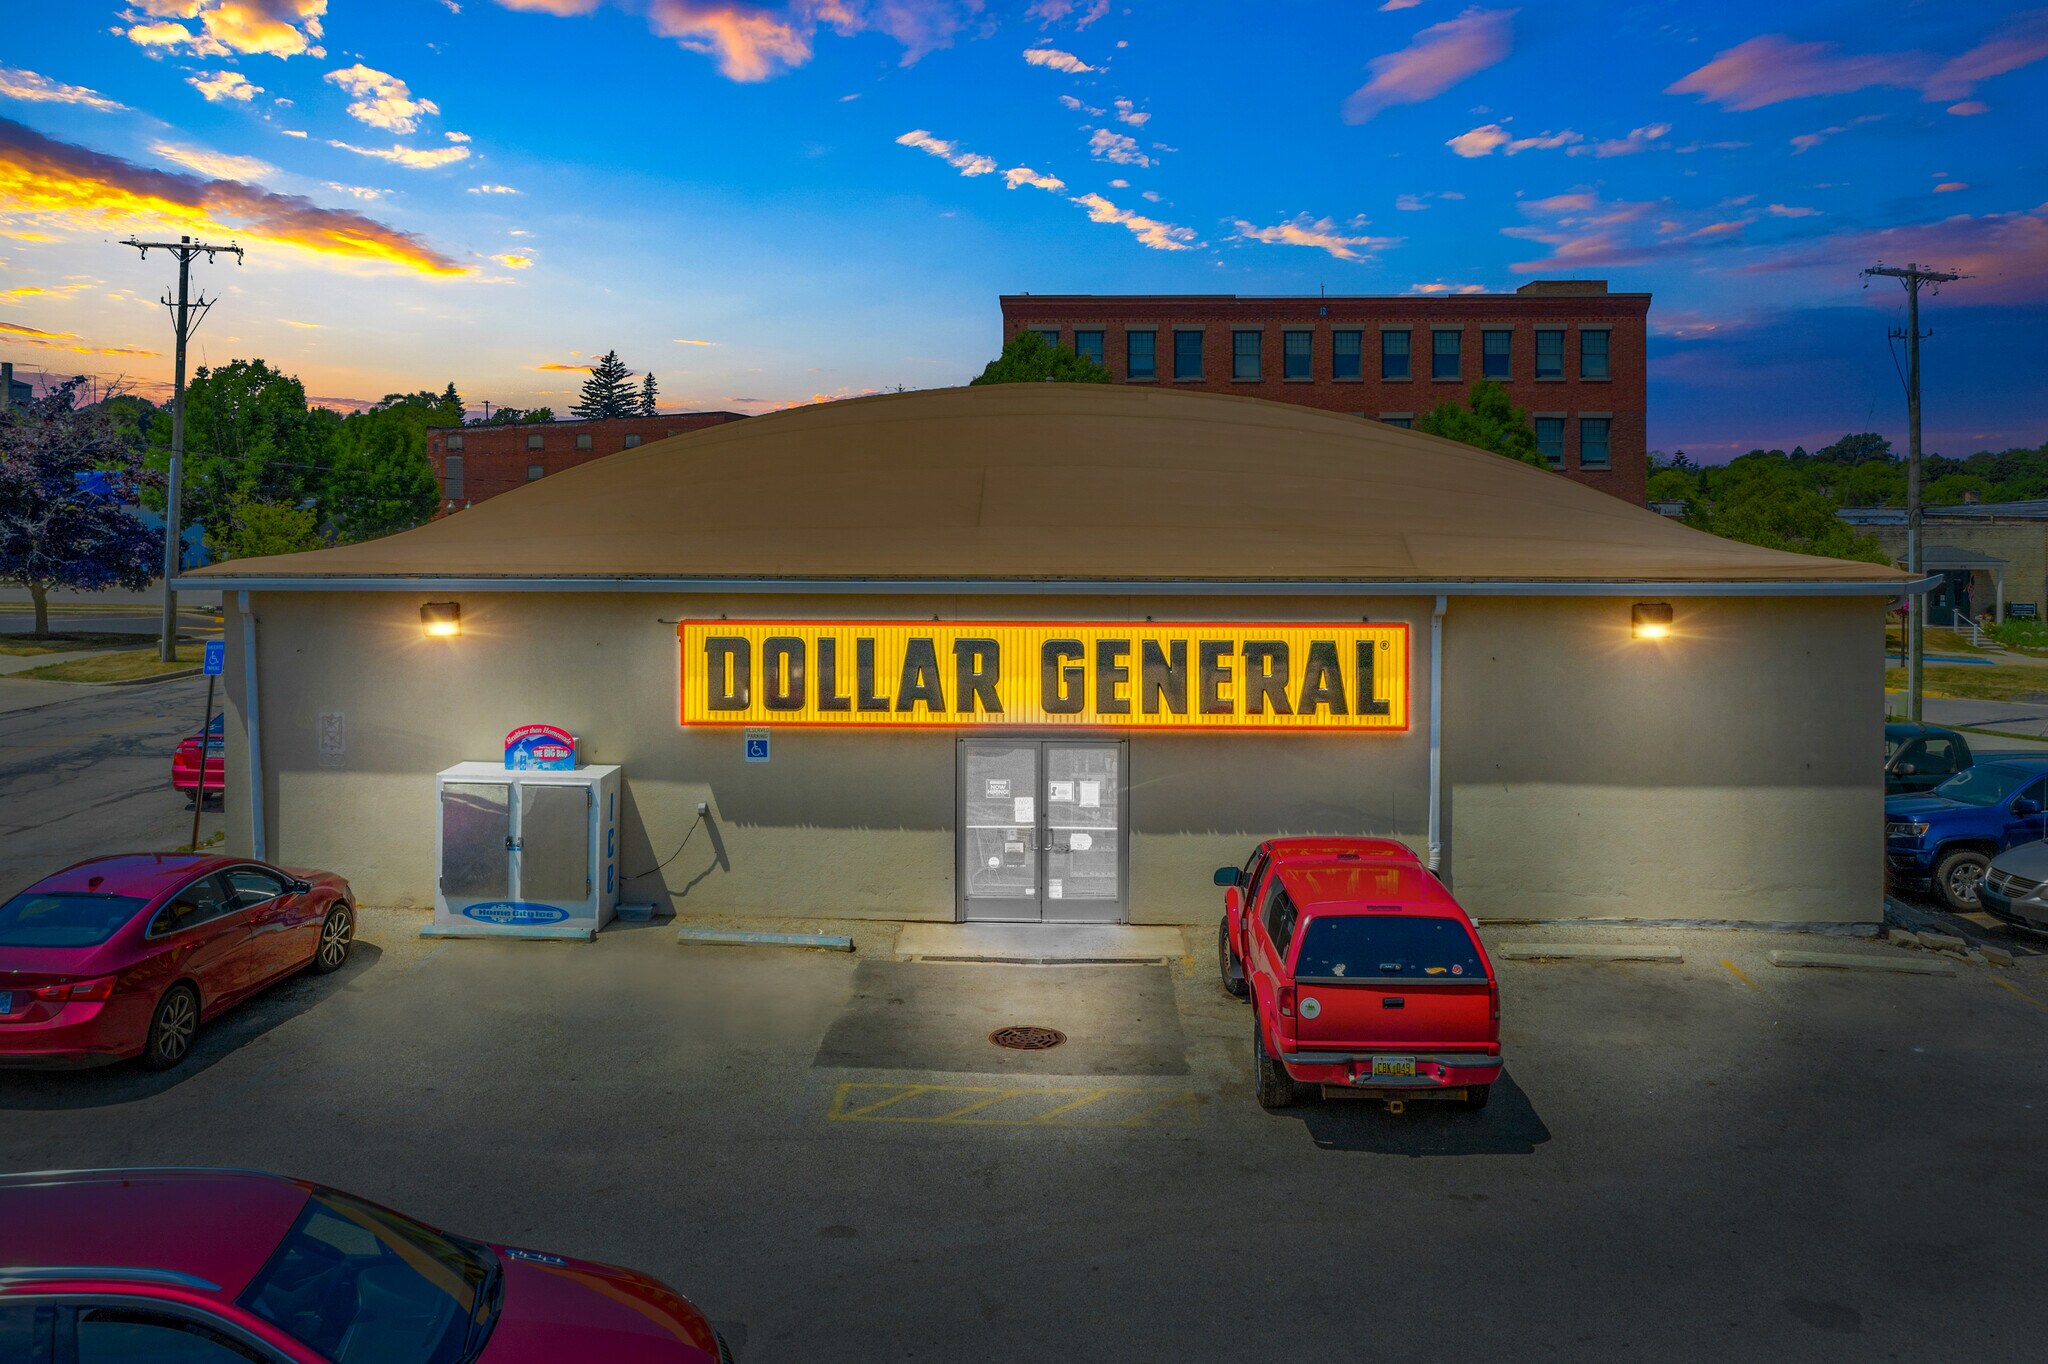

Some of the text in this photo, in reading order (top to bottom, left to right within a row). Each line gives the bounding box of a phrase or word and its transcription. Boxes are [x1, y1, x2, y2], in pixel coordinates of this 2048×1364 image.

[705, 635, 1391, 716] DOLLAR GENERAL
[506, 726, 572, 745] Healthier than Homemade
[533, 748, 568, 758] THE BIG BAG
[478, 908, 511, 916] Home
[512, 909, 534, 919] City
[1378, 1062, 1392, 1074] CBK
